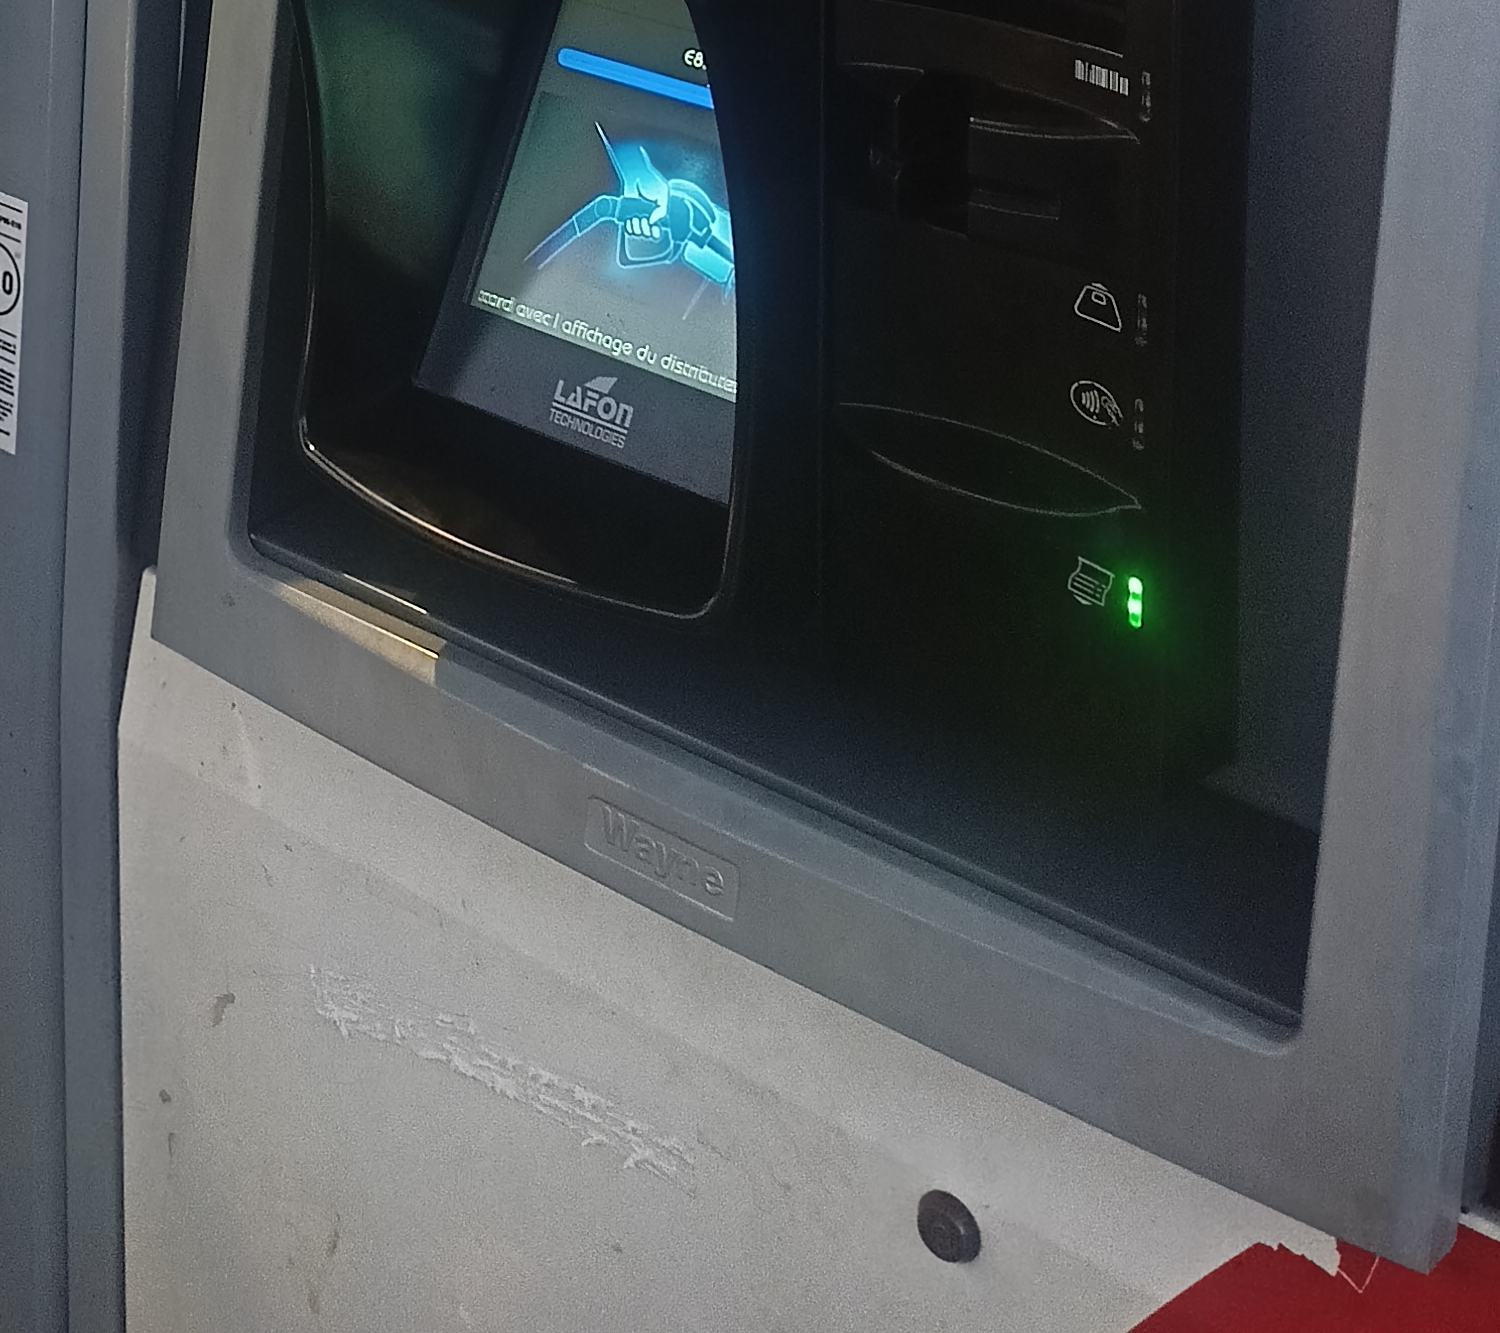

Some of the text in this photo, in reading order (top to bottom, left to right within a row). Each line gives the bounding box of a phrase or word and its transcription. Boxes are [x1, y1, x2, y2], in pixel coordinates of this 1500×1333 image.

[516, 304, 552, 327] avec
[636, 344, 658, 365] du
[549, 407, 627, 449] TECHNOLOGIES
[552, 379, 634, 428] LAFON
[602, 805, 725, 897] Wayne
